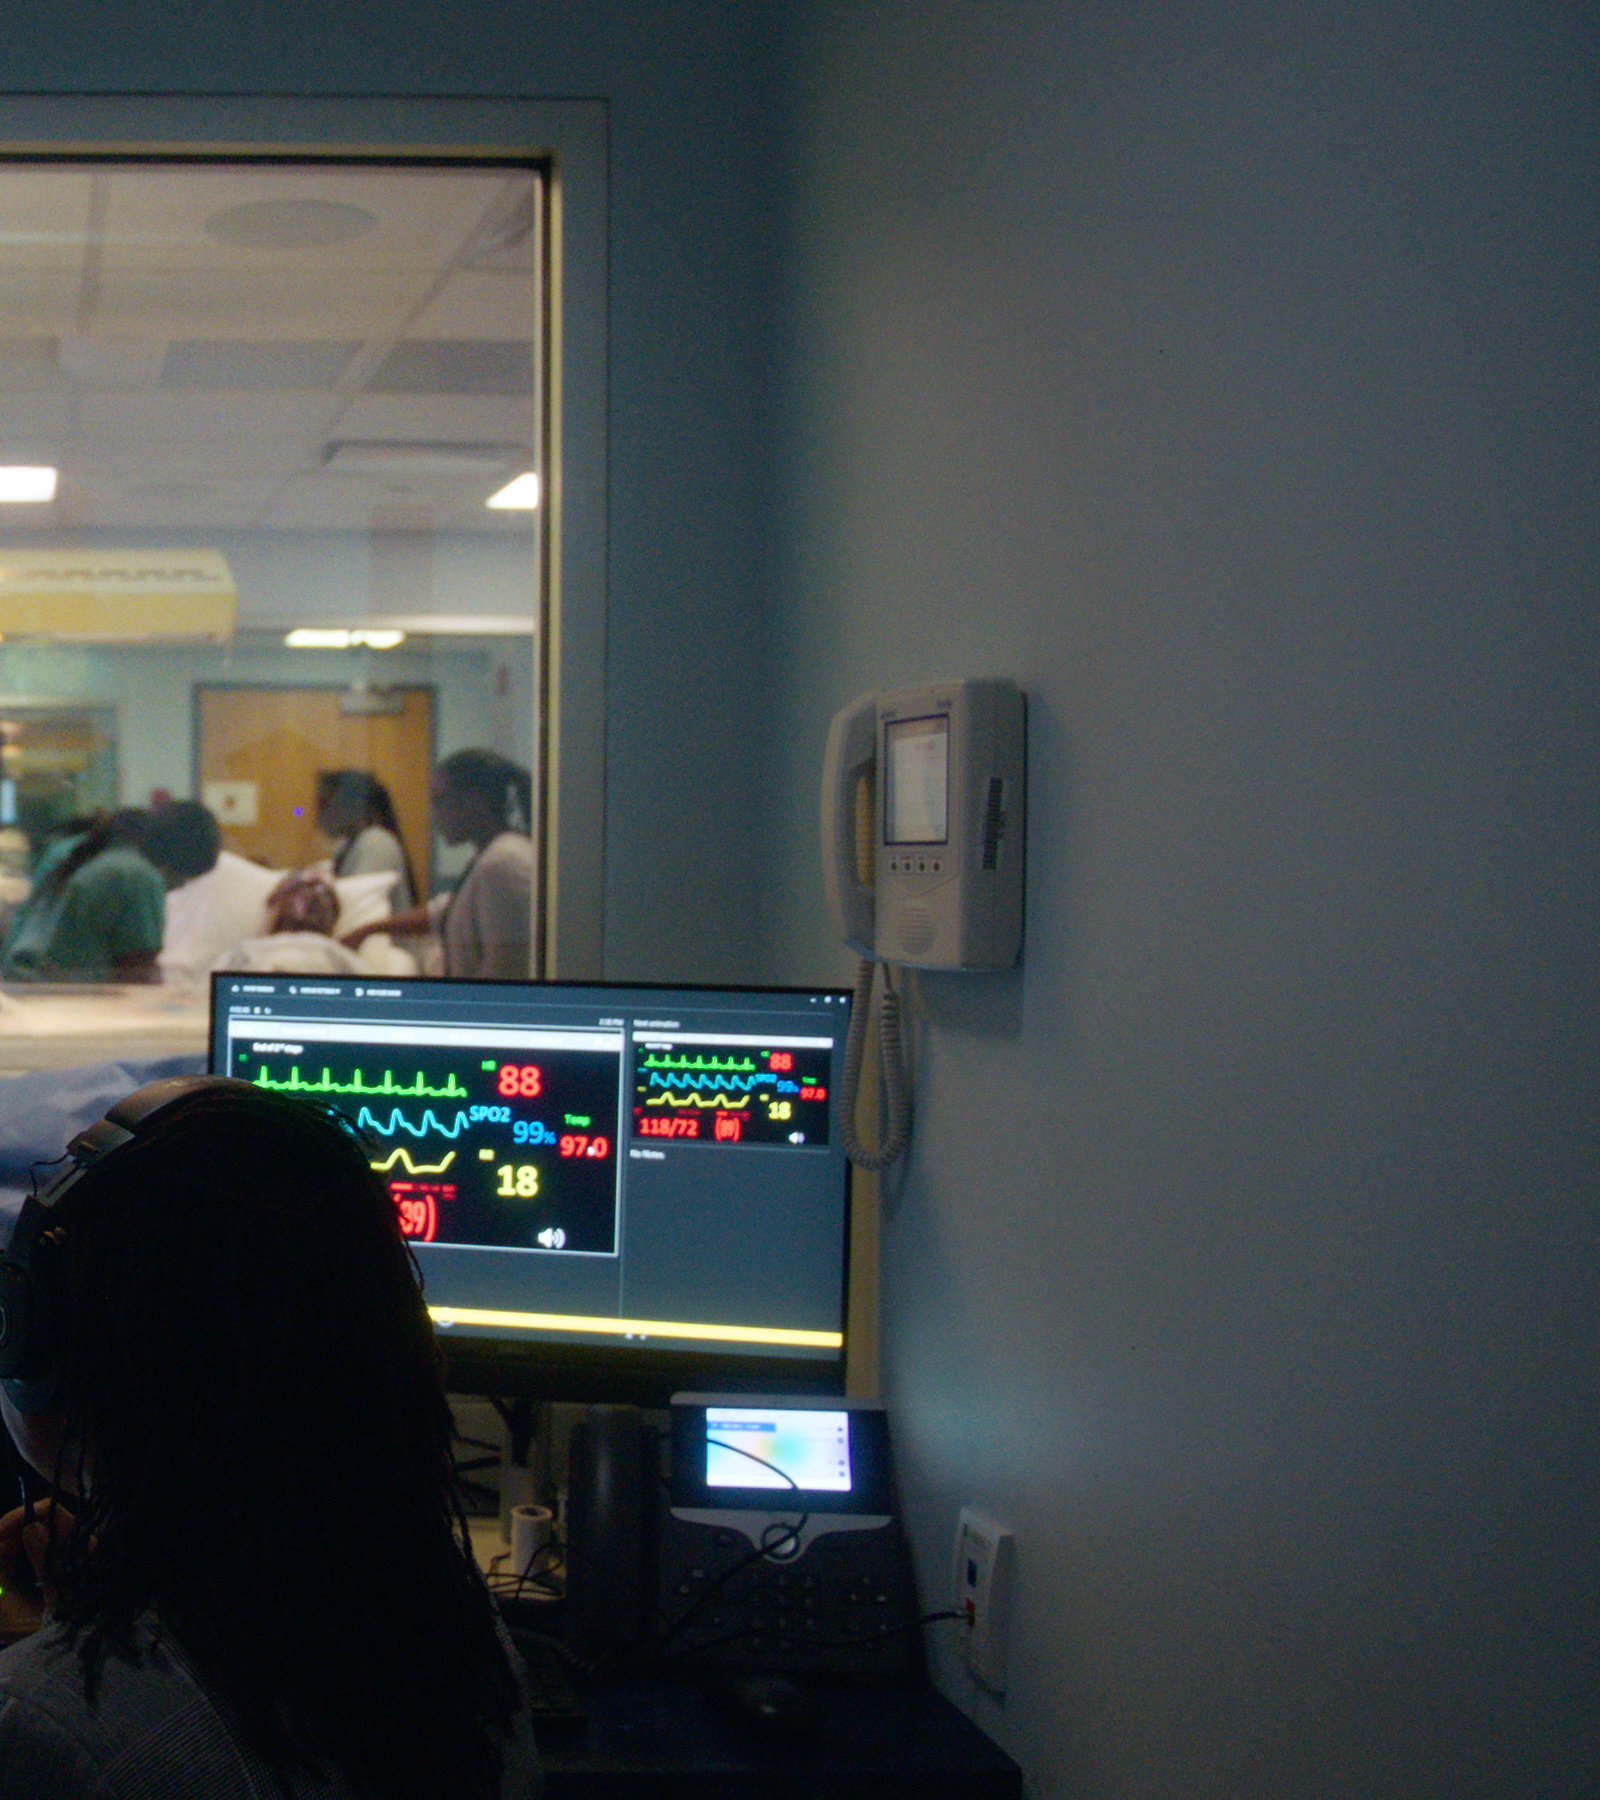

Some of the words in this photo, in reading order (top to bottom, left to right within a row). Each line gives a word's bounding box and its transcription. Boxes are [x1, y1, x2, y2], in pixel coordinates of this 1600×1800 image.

[768, 1052, 793, 1072] 88
[498, 1064, 542, 1098] 88
[767, 1101, 792, 1120] 18
[638, 1116, 699, 1139] 118/72
[496, 1164, 540, 1198] 18
